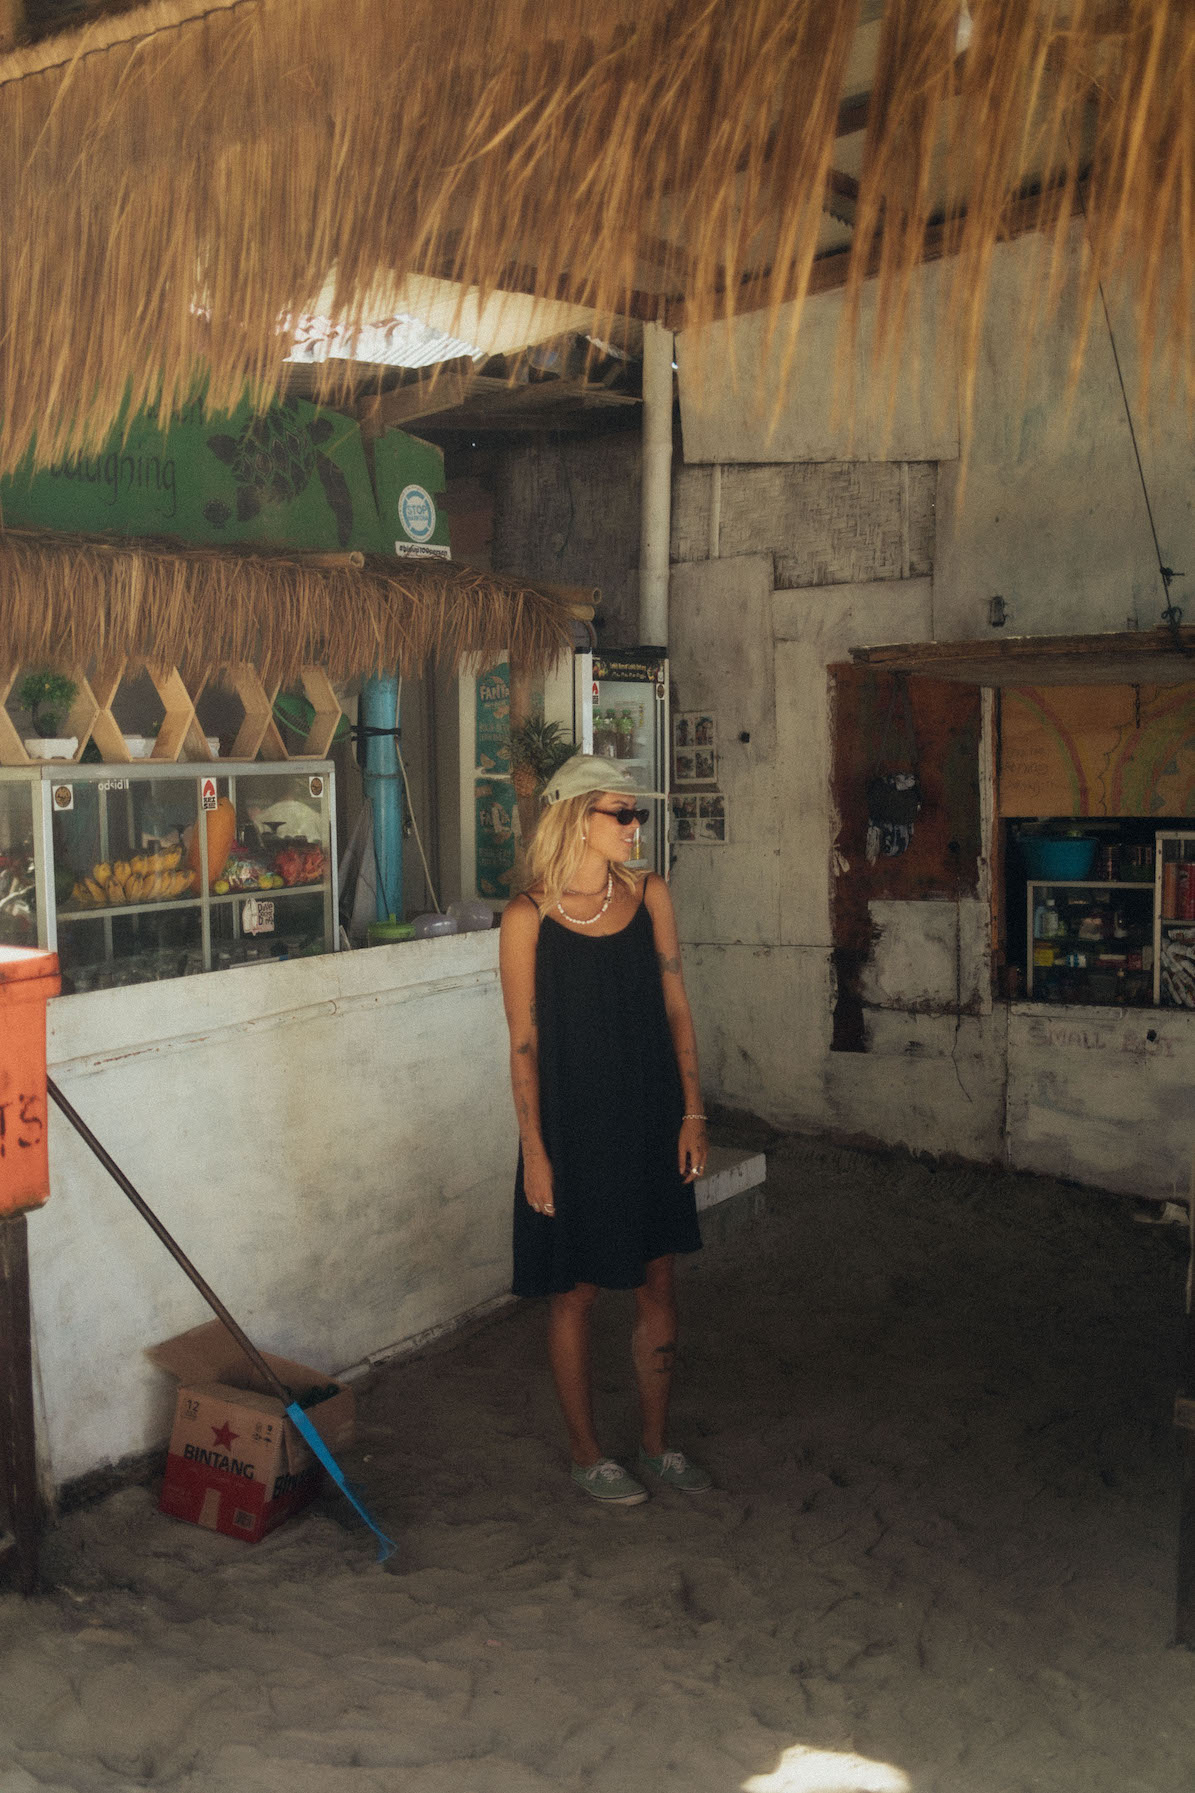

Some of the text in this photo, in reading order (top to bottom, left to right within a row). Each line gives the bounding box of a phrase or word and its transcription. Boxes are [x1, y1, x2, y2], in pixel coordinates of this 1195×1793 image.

[406, 504, 428, 515] STOP
[186, 1399, 200, 1412] 12
[183, 1443, 255, 1480] BINTANG
